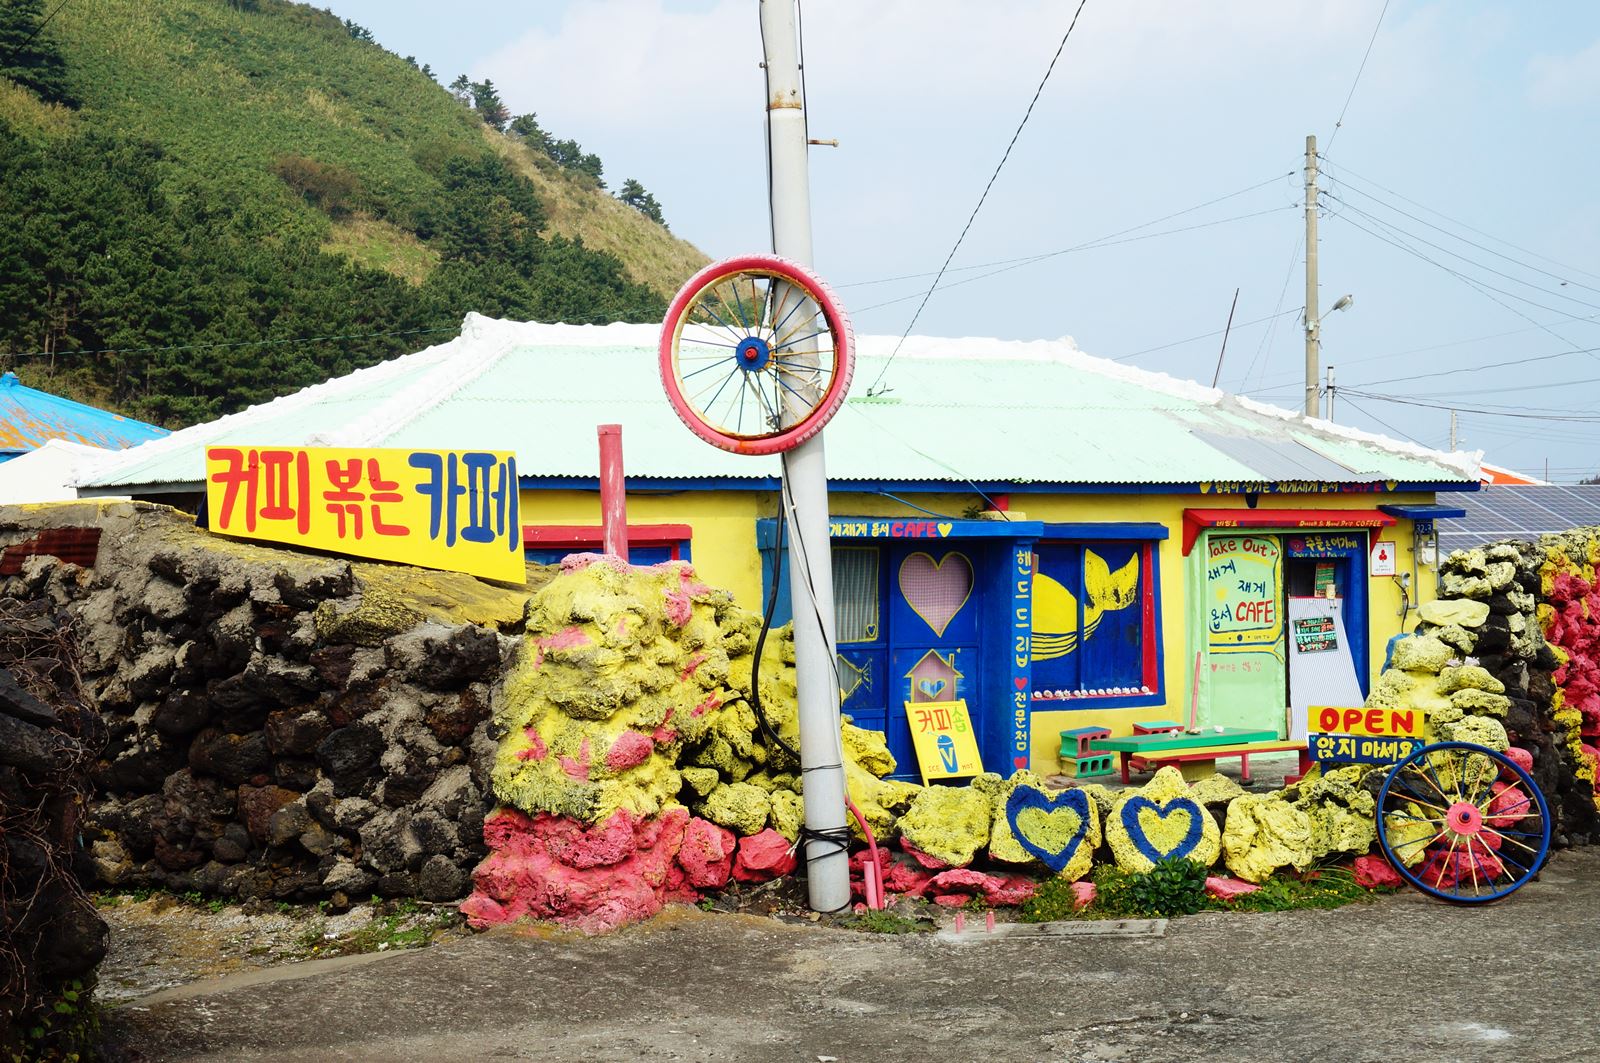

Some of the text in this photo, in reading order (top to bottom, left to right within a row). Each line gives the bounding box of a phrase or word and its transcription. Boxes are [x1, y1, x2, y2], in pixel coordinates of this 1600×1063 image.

[208, 448, 519, 552] 커피 볶는 카페
[891, 521, 937, 537] CAFE
[1355, 519, 1382, 527] COFFEE
[1208, 538, 1268, 558] Take Out
[1237, 580, 1266, 598] 재게
[1015, 550, 1031, 668] 핸드드립
[1235, 599, 1274, 623] CAFE
[914, 706, 968, 733] 커피숍
[1014, 691, 1027, 752] 전문점
[1320, 707, 1414, 734] OPEN
[1316, 737, 1414, 763] 앉지 마세요
